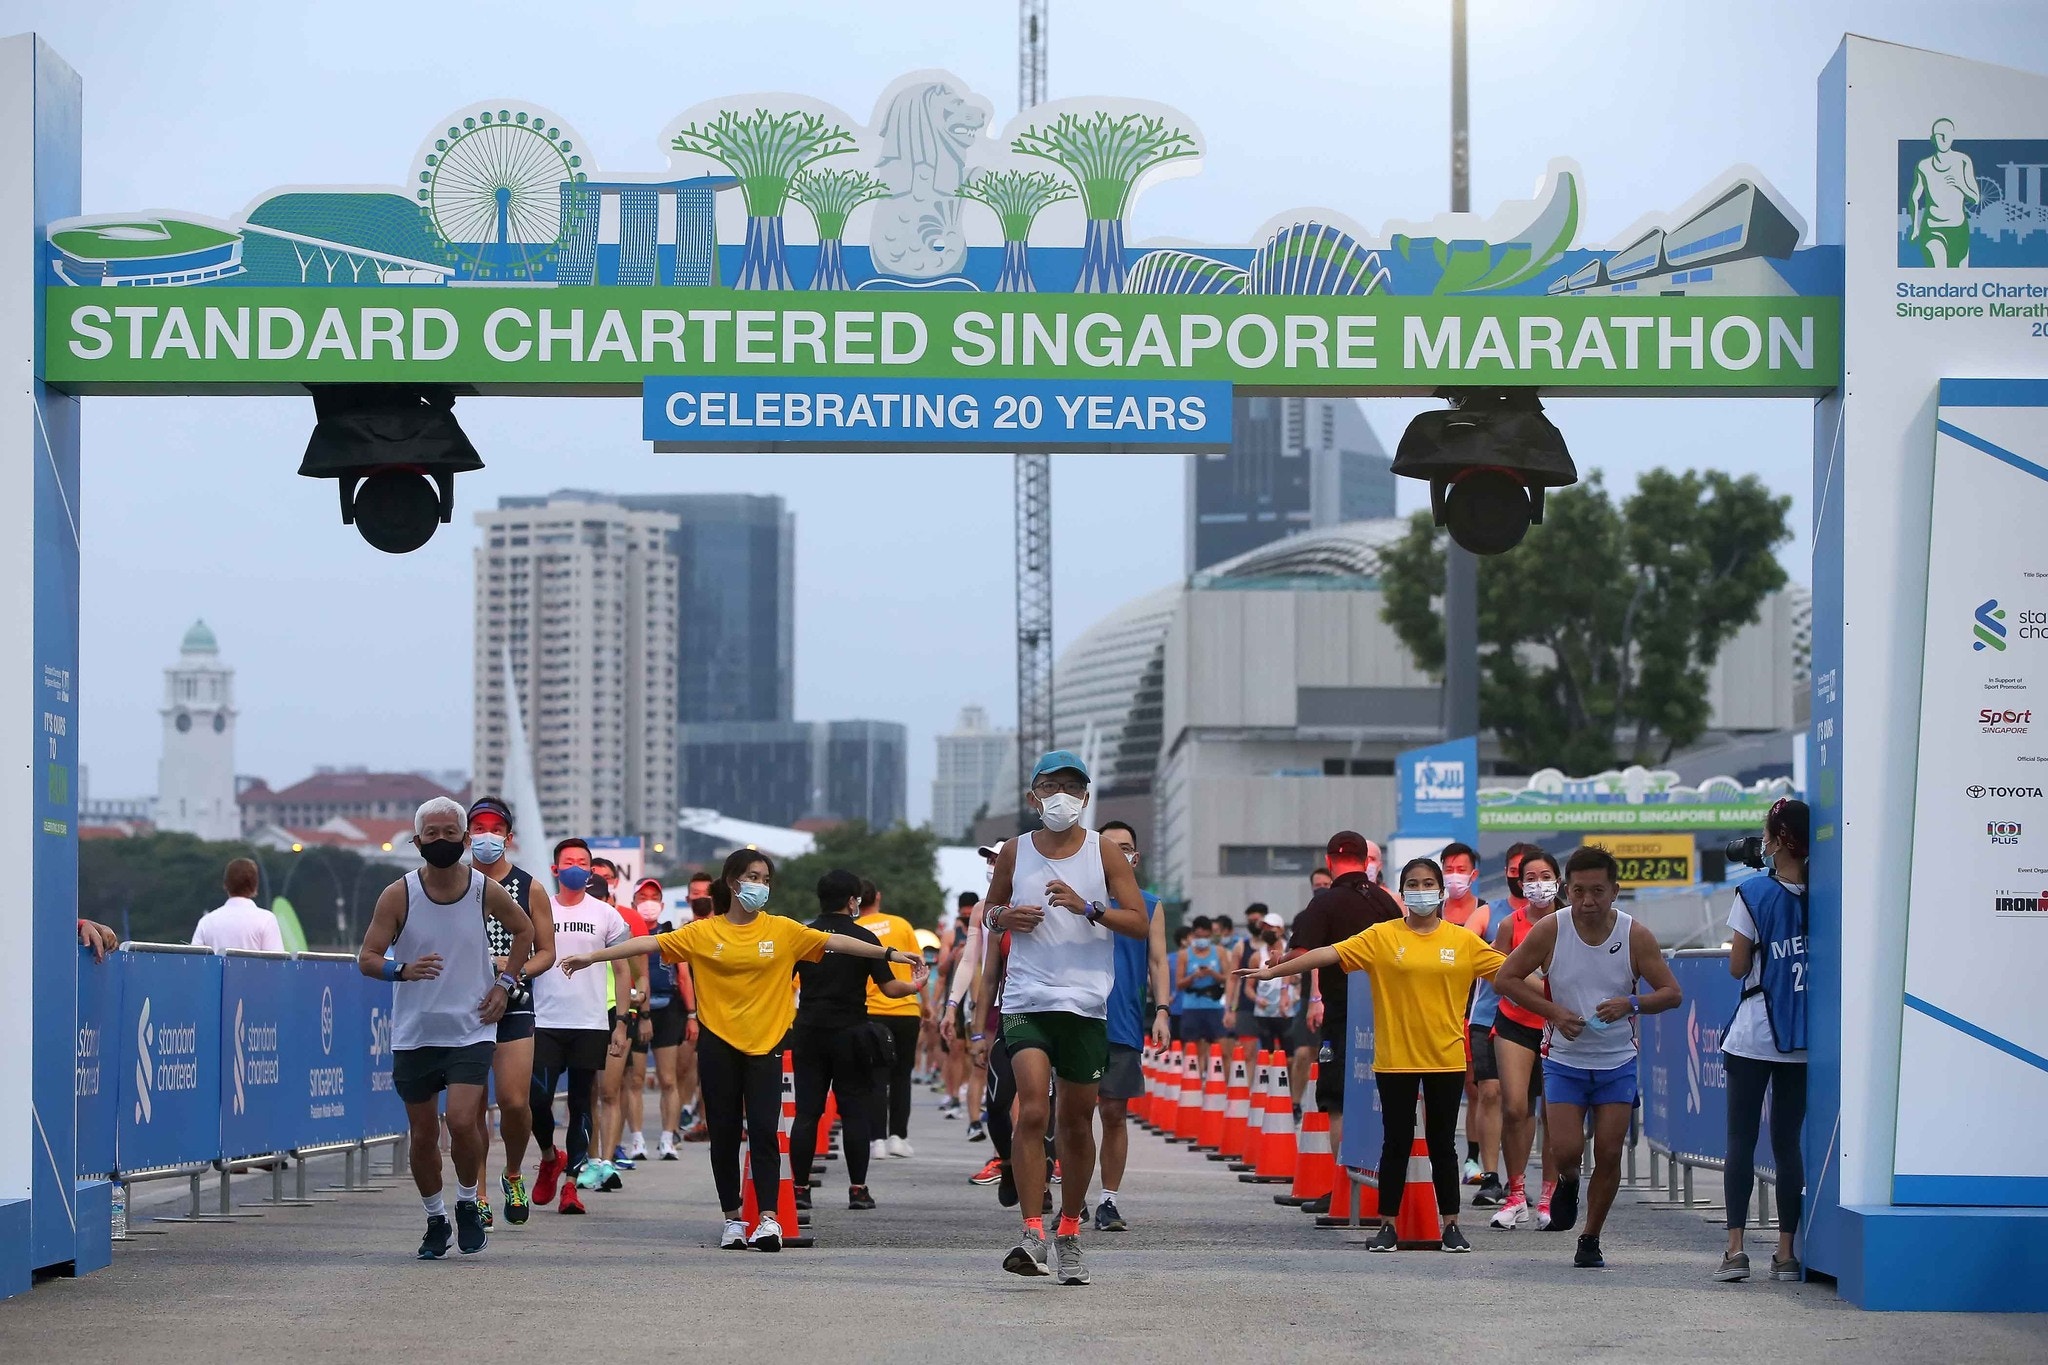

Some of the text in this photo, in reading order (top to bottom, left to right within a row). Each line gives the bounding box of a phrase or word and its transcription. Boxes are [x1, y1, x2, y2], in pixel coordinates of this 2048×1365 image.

[1896, 282, 2048, 298] Standard Charter
[1896, 302, 2048, 321] Singapore Marath
[2031, 322, 2048, 338] 20
[68, 305, 1815, 372] STANDARD CHARTERED SINGAPORE MARATHON
[665, 392, 1207, 431] CELEBRATING 20 YEARS
[2019, 609, 2047, 624] sta
[2019, 624, 2048, 639] cha
[1978, 709, 2032, 726] Sport
[1988, 787, 2044, 798] TOYOTA
[1480, 810, 1551, 825] STANDARD
[1554, 809, 1637, 824] CHARTERED
[1639, 809, 1716, 823] SINGAPORE
[1719, 809, 1767, 823] MARAT
[1989, 821, 2019, 837] 100
[1991, 837, 2019, 845] PLUS
[1995, 897, 2048, 912] IRONM
[563, 921, 596, 936] FORCE
[1791, 961, 1808, 992] 2
[158, 1021, 196, 1056] standard
[248, 1022, 277, 1053] standard
[157, 1056, 198, 1092] chartered
[247, 1054, 279, 1086] chartered
[1702, 1057, 1727, 1089] charter
